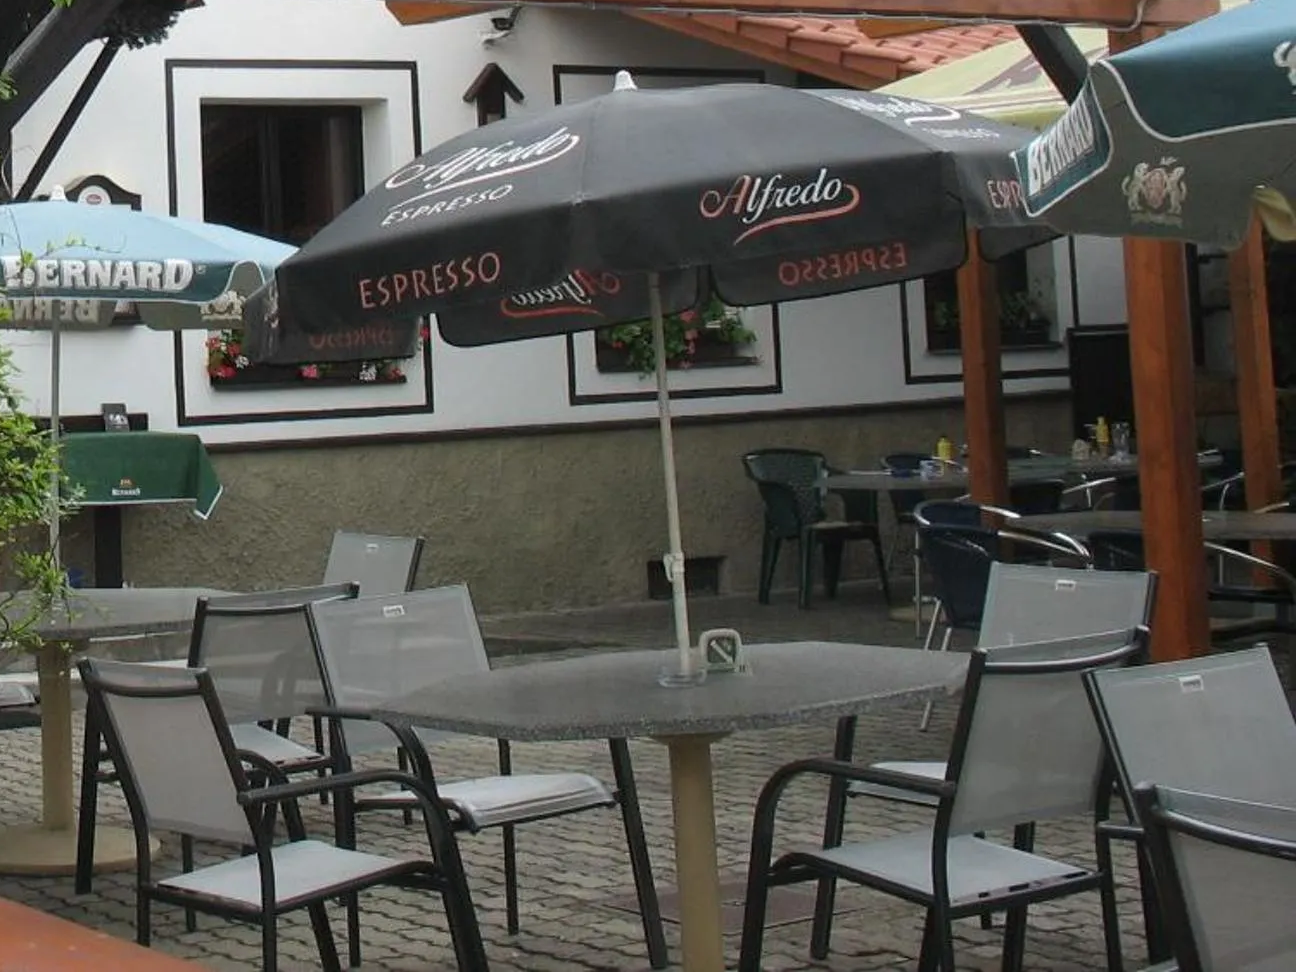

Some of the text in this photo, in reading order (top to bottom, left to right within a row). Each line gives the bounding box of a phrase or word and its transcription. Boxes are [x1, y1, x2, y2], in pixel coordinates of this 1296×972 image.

[380, 184, 514, 228] ESPRESSO
[699, 168, 856, 228] Alfredo
[359, 251, 501, 310] ESPRESSO
